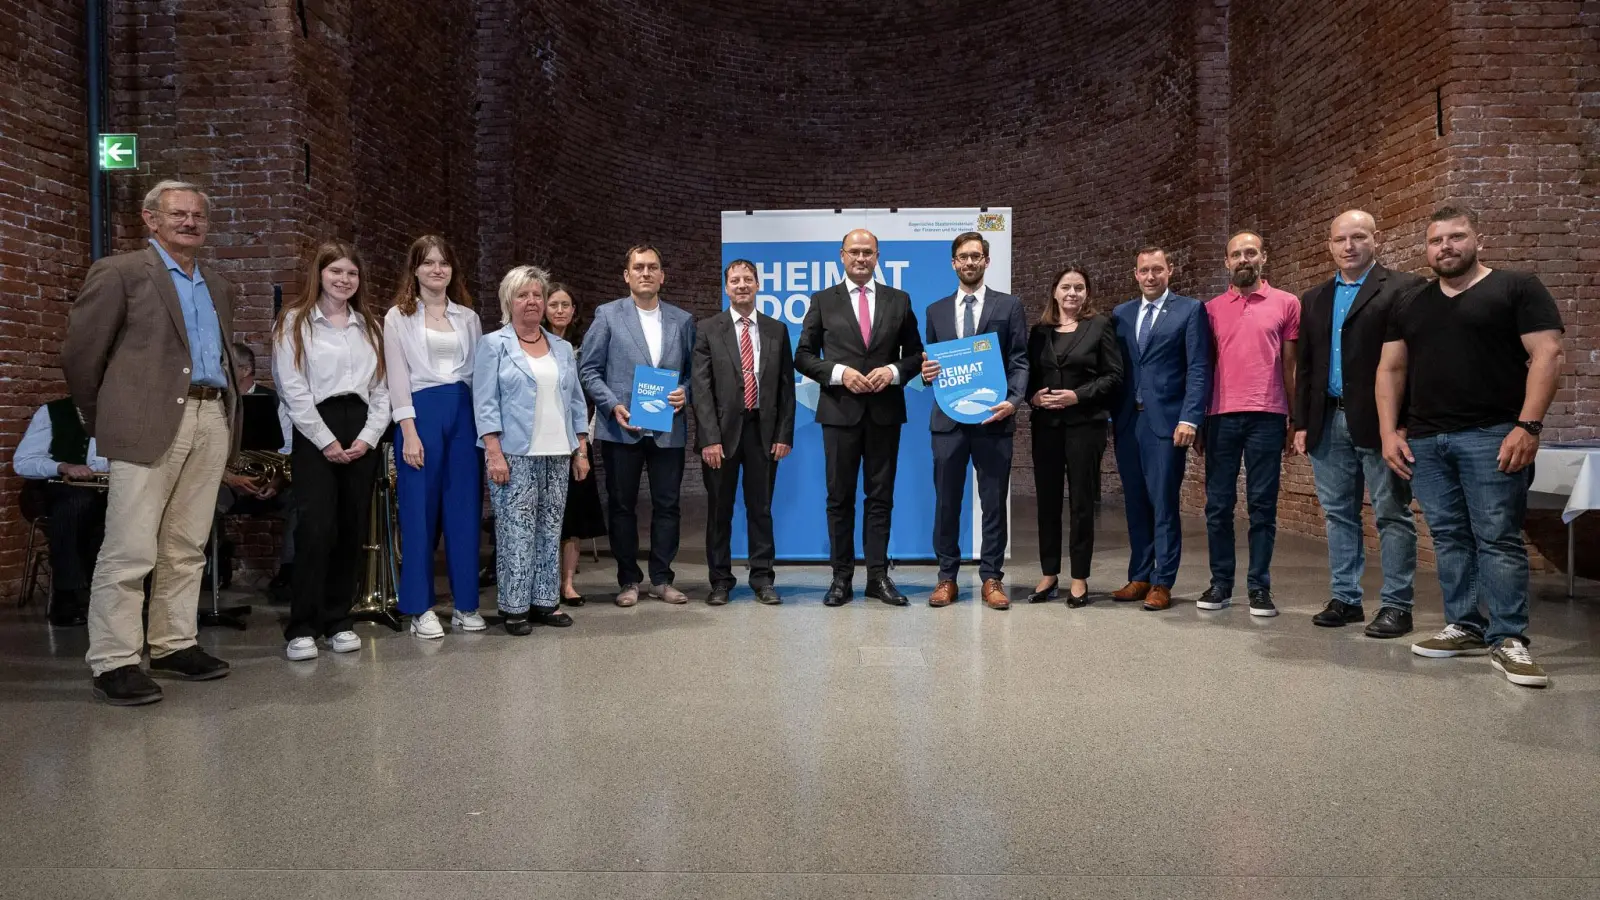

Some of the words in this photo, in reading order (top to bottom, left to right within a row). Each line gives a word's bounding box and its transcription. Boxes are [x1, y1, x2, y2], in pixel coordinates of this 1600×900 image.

[755, 293, 812, 325] DO
[938, 361, 983, 379] HEIMAT
[638, 382, 664, 392] HEIMAT
[938, 373, 972, 388] DORF
[637, 388, 656, 396] DORF
